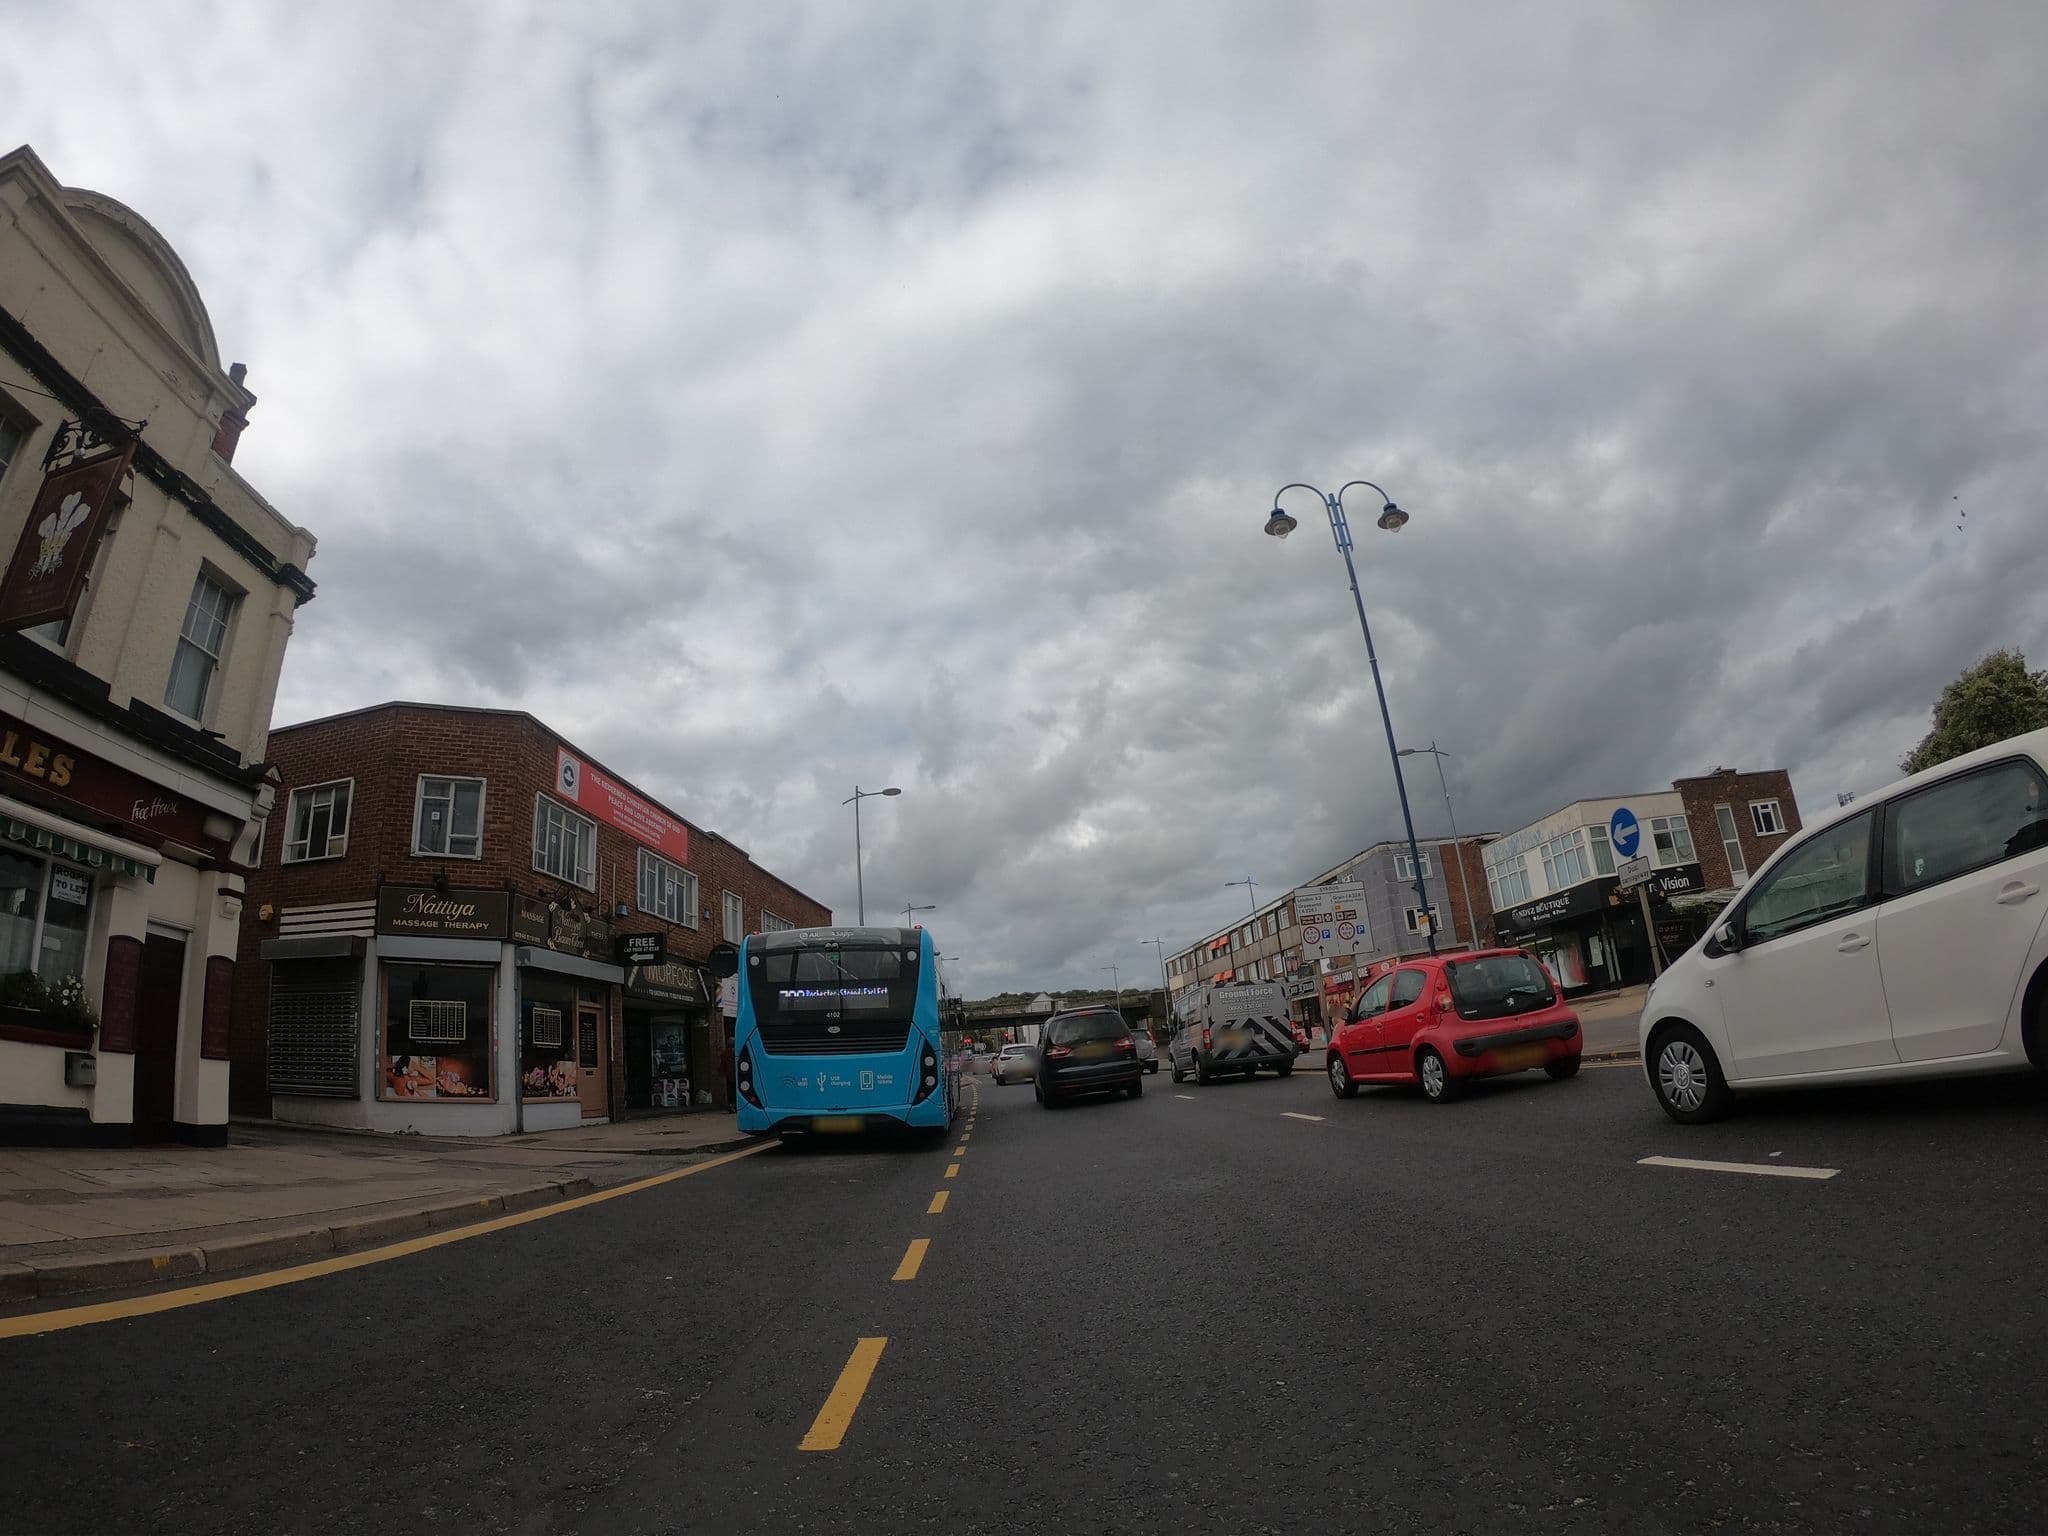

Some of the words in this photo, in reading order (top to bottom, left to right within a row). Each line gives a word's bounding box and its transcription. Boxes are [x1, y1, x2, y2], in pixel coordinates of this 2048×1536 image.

[590, 773, 601, 785] THE
[602, 780, 626, 801] REDEEMED
[627, 796, 650, 815] CHRISTIAN
[608, 795, 623, 809] PEACE
[131, 799, 150, 821] Free
[150, 796, 176, 817] House
[55, 867, 89, 883] ROOMS
[55, 879, 69, 889] TO
[69, 882, 88, 895] LET
[1659, 876, 1690, 891] Vision
[403, 893, 475, 921] Nattiya
[392, 919, 439, 928] MASSAGE
[443, 921, 490, 930] THERAPY
[628, 936, 655, 947] FREE
[648, 962, 694, 989] MORFOSE
[1219, 988, 1250, 999] Ground
